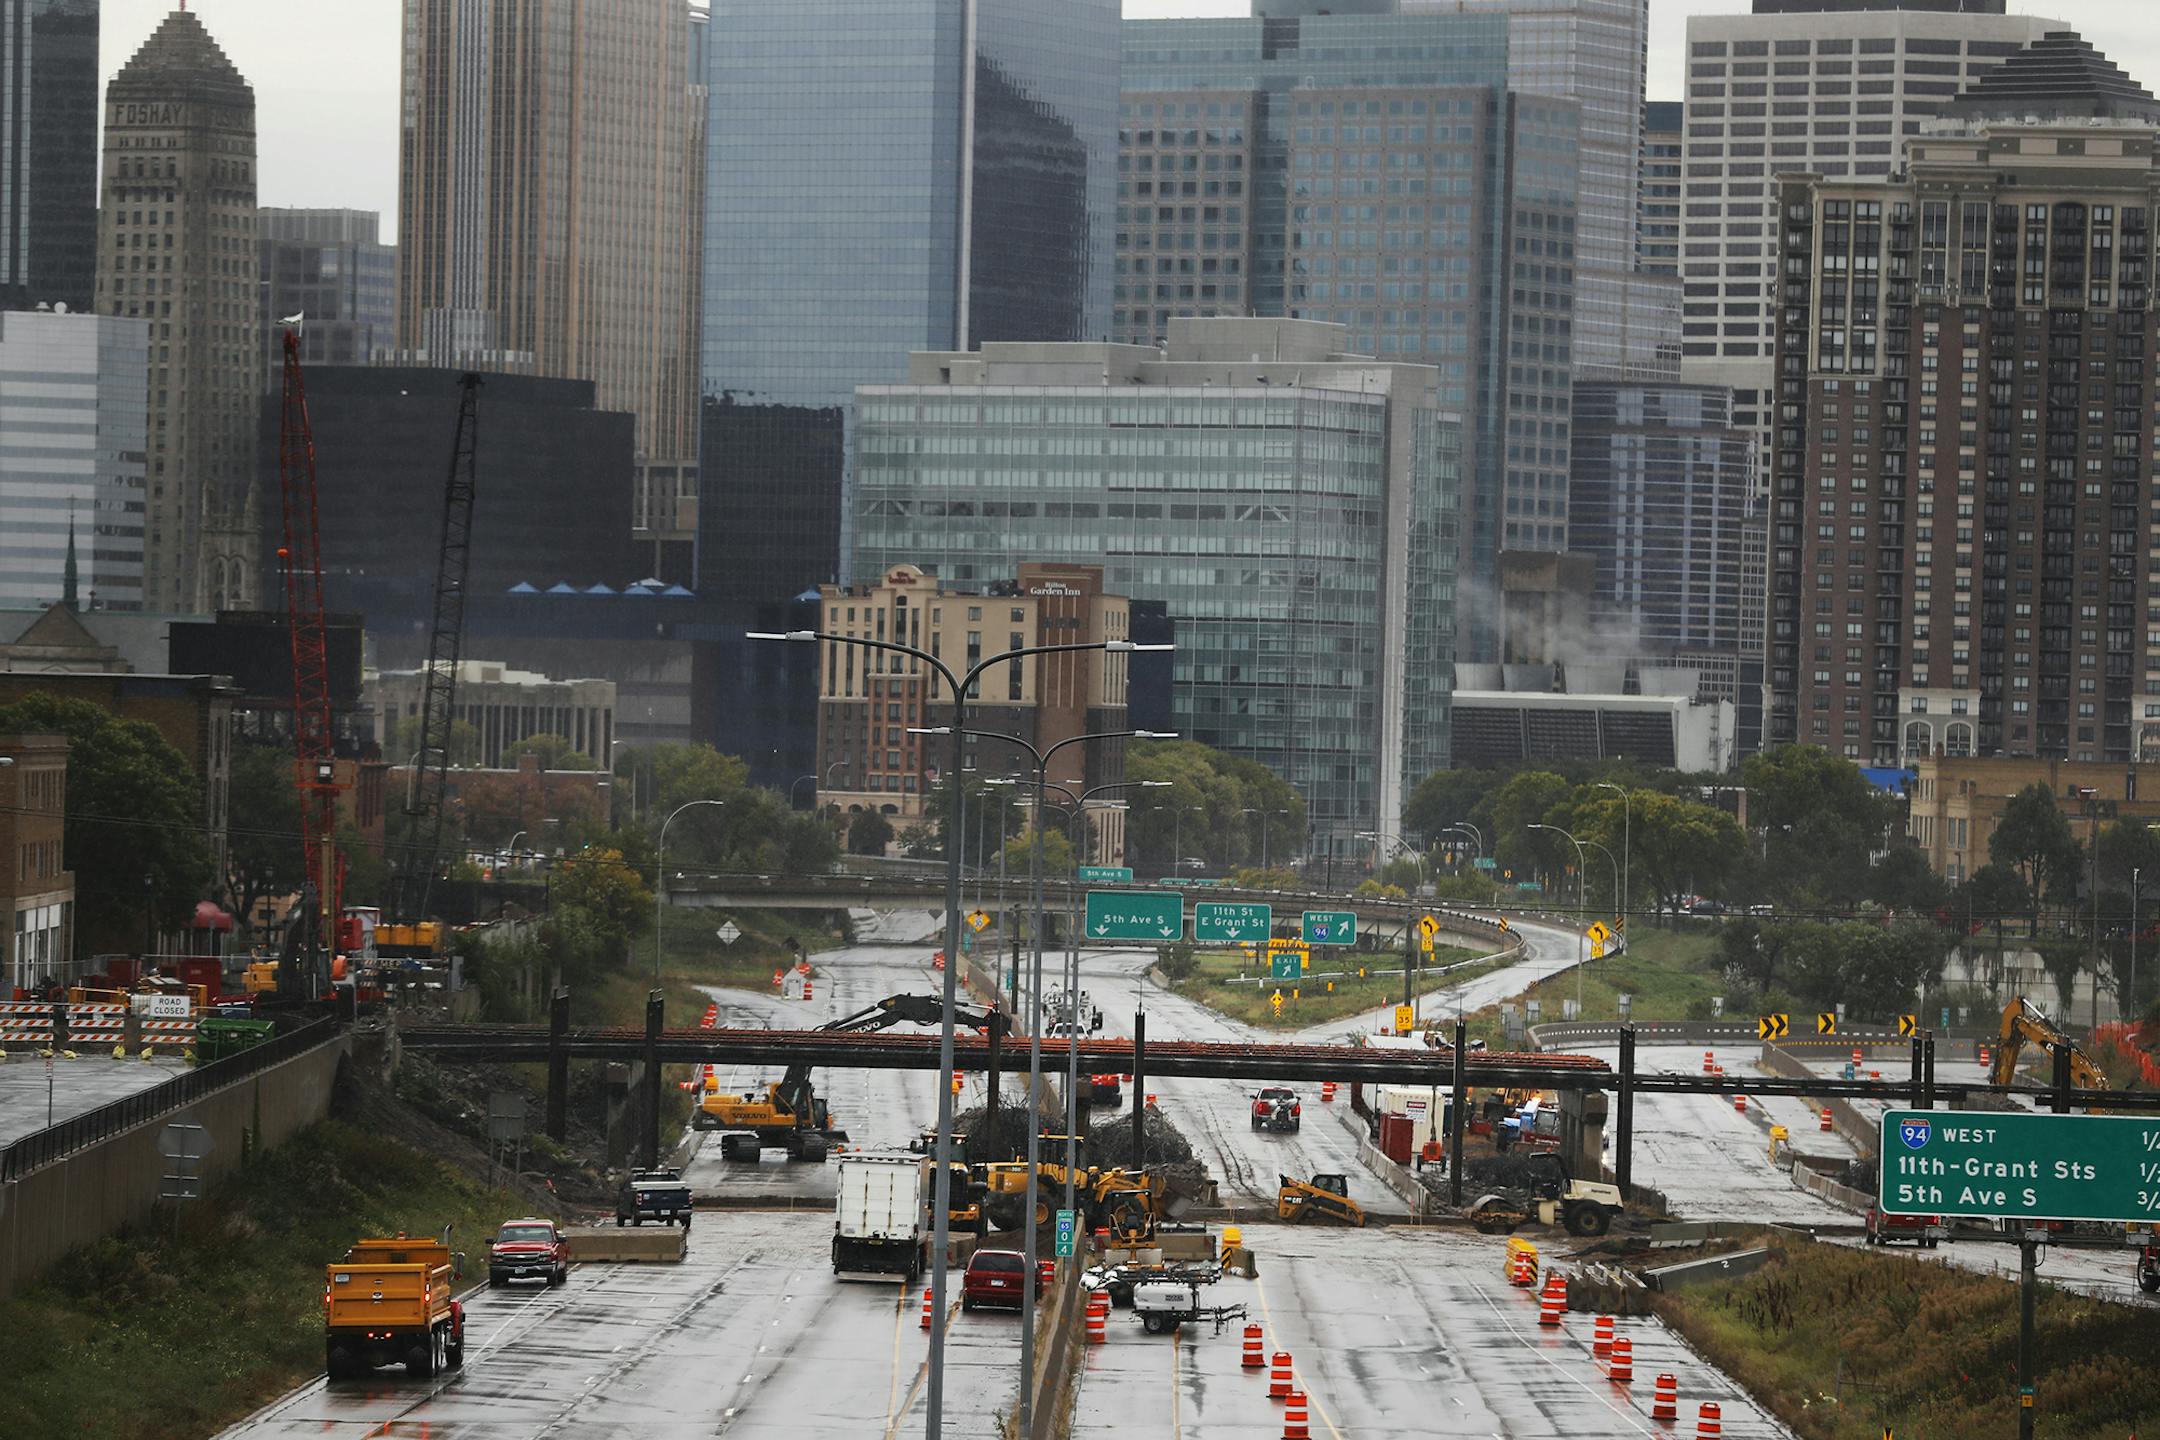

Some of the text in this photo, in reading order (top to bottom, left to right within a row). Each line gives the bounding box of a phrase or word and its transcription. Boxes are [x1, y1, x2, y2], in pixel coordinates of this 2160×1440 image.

[114, 103, 183, 125] FOSHAY
[1030, 586, 1081, 596] Garden Inn
[1213, 907, 1253, 916] 11th St
[1104, 914, 1164, 924] 5th Ave S
[1202, 917, 1264, 927] E Grant St
[1309, 914, 1334, 922] WEST
[1315, 928, 1326, 936] 94
[154, 1007, 186, 1015] CLOSED
[1398, 1016, 1410, 1024] 35
[1904, 1127, 1927, 1142] 94
[1942, 1128, 1997, 1143] WEST
[1898, 1156, 2038, 1178] 11th-Grant
[2054, 1160, 2096, 1180] Sts
[1898, 1184, 1943, 1204] 5th
[1958, 1186, 2007, 1206] Ave
[2022, 1187, 2037, 1206] S
[1061, 1232, 1068, 1241] 0
